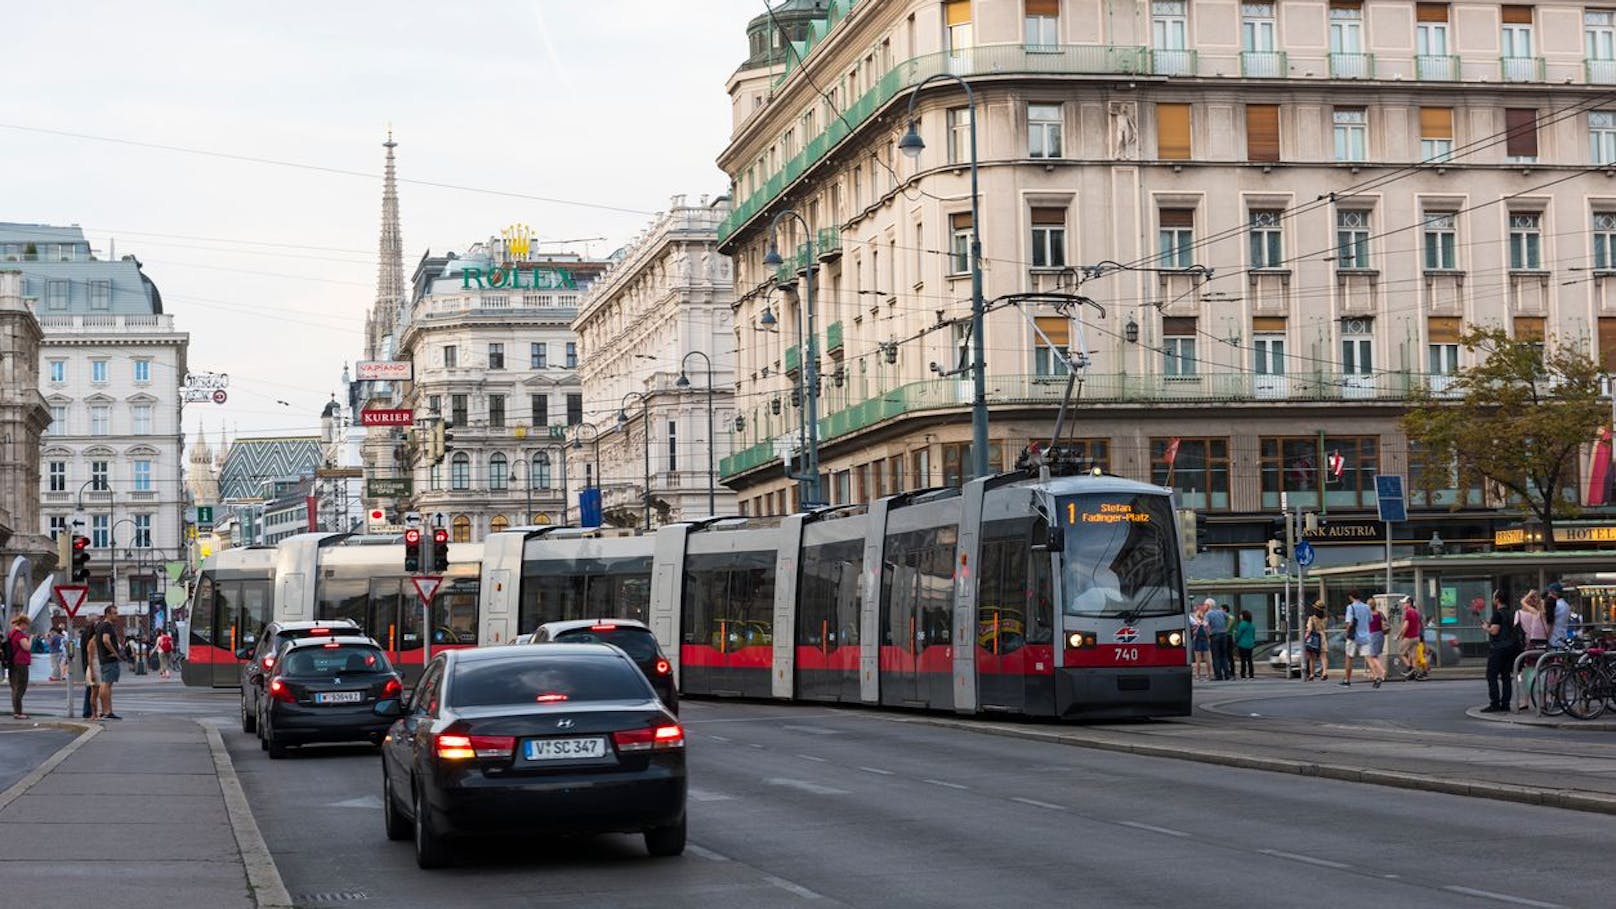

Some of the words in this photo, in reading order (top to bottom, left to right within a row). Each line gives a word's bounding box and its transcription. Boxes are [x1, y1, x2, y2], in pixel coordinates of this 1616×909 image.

[461, 266, 578, 289] ROLEX
[364, 413, 410, 422] KURIER
[1066, 502, 1076, 524] 1
[1101, 503, 1131, 512] Stefan
[1082, 512, 1151, 523] Fadinger-Platz
[1329, 525, 1376, 536] AUSTRIA
[1567, 527, 1616, 540] HOTEL
[1114, 648, 1138, 660] 740
[536, 741, 546, 755] V
[553, 740, 571, 754] SC
[573, 739, 598, 752] 347
